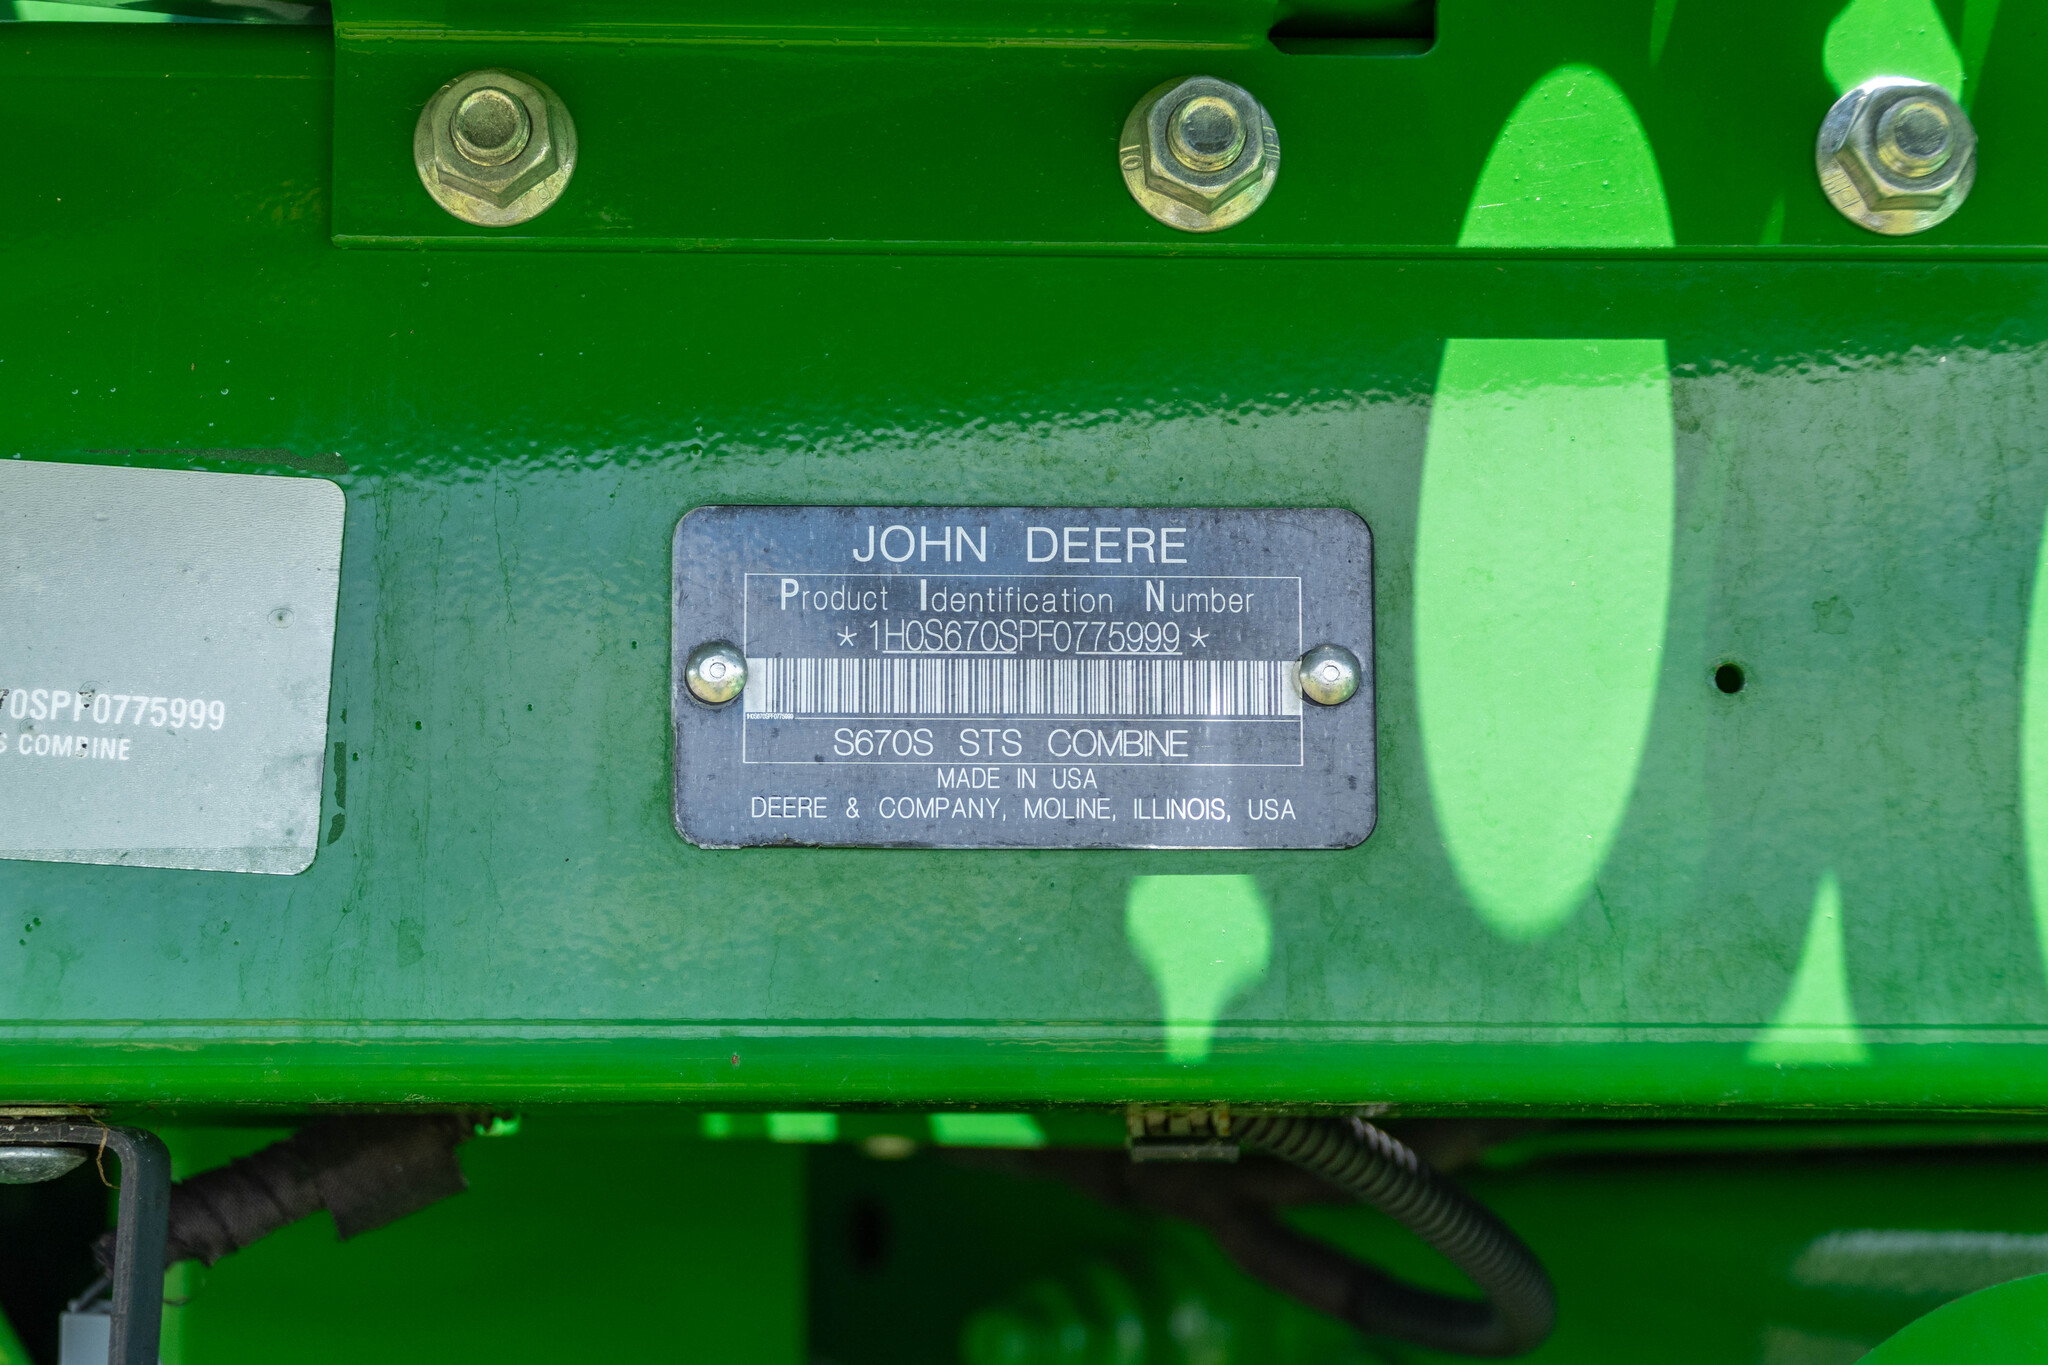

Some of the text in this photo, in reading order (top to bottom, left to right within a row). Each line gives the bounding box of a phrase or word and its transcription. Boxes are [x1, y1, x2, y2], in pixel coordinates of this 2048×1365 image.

[852, 524, 1188, 564] JOHN DEERE
[780, 577, 1255, 614] Product Identification Number
[18, 733, 131, 761] COMBINE
[833, 728, 1189, 758] S670S STS COMBINE
[937, 767, 1098, 790] MADE IN USA
[751, 796, 1297, 823] DEERE & COMPANY, MOLINE, ILLINOIS, USA
